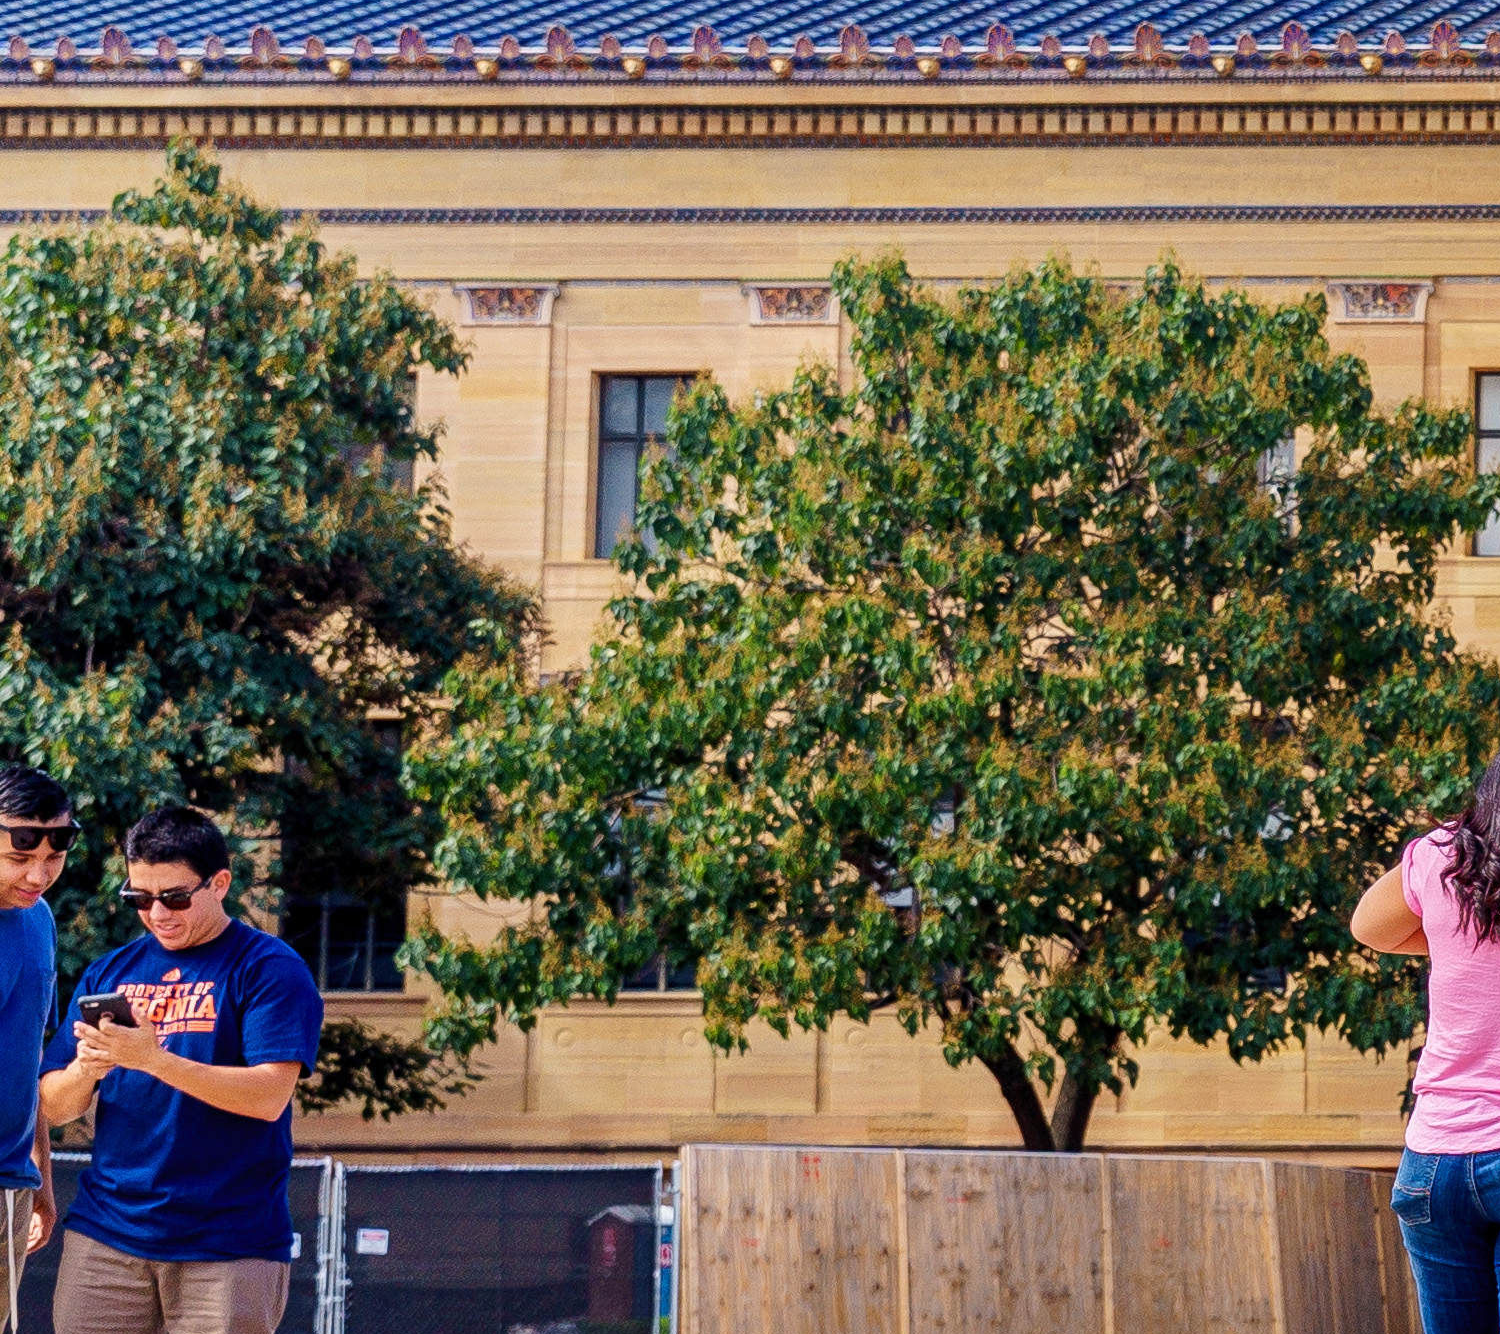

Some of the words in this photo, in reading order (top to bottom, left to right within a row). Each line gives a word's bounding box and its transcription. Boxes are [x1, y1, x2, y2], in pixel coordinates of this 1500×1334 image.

[116, 983, 193, 999] PROPERTY
[193, 981, 215, 995] OF
[127, 994, 217, 1023] RGINIA
